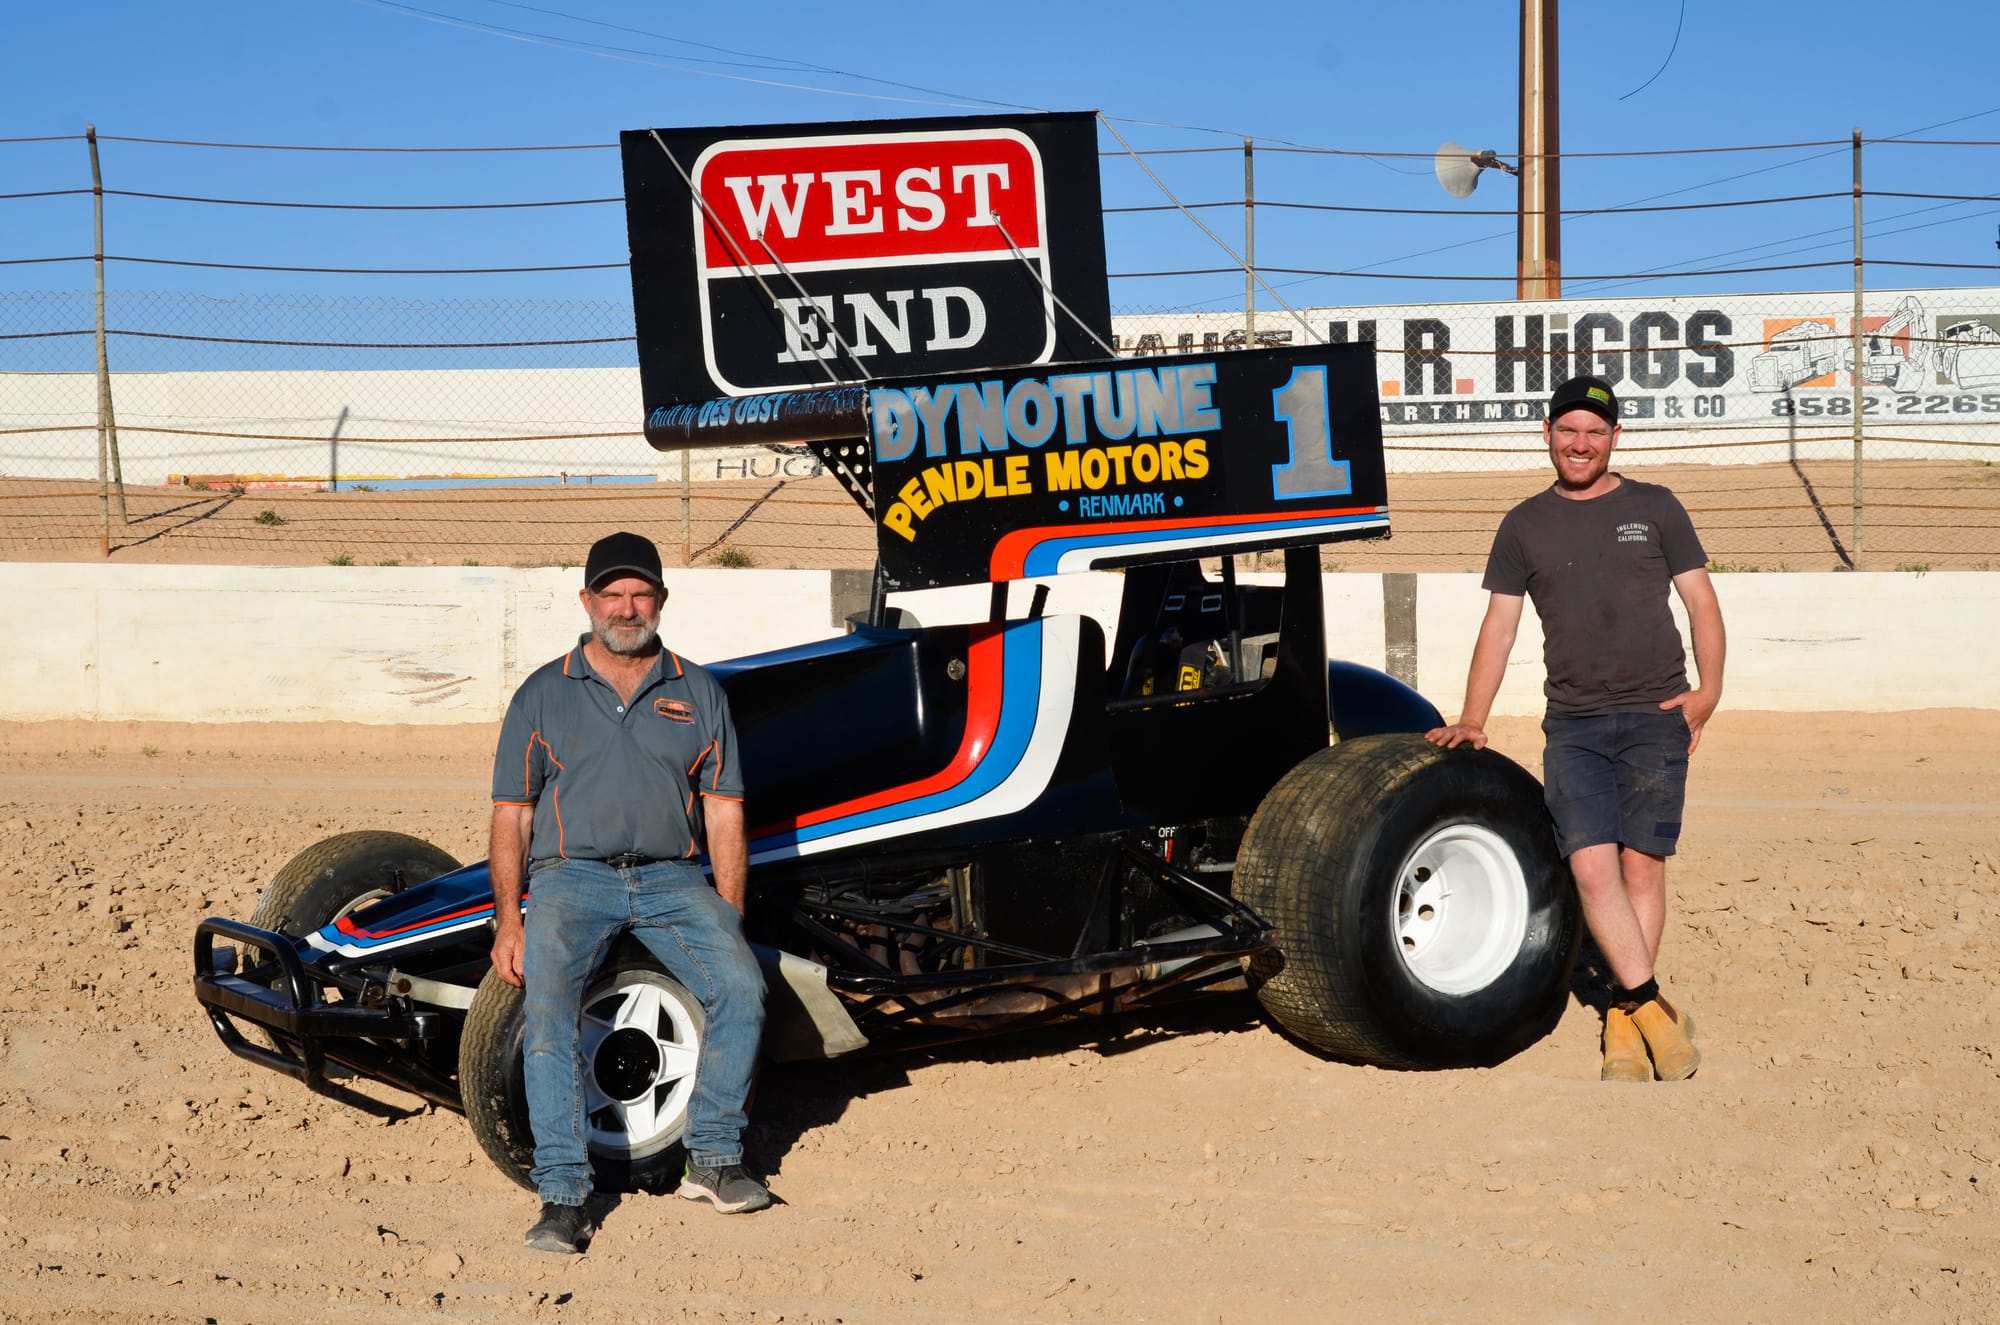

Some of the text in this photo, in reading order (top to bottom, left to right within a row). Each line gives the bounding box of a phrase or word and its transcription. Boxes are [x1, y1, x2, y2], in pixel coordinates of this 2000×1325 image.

[723, 162, 1009, 241] WEST
[773, 286, 987, 363] END
[698, 400, 733, 428] DES
[734, 393, 788, 424] OBST
[870, 362, 1220, 463] DYNOTUNE
[1272, 365, 1353, 501] 1
[1664, 398, 1684, 418] &
[1694, 395, 1726, 417] CO
[883, 439, 1209, 543] PENDLE MOTORS
[1079, 492, 1165, 517] RENMARK
[1618, 534, 1648, 543] CALIFORNIA
[1158, 826, 1176, 838] OFF
